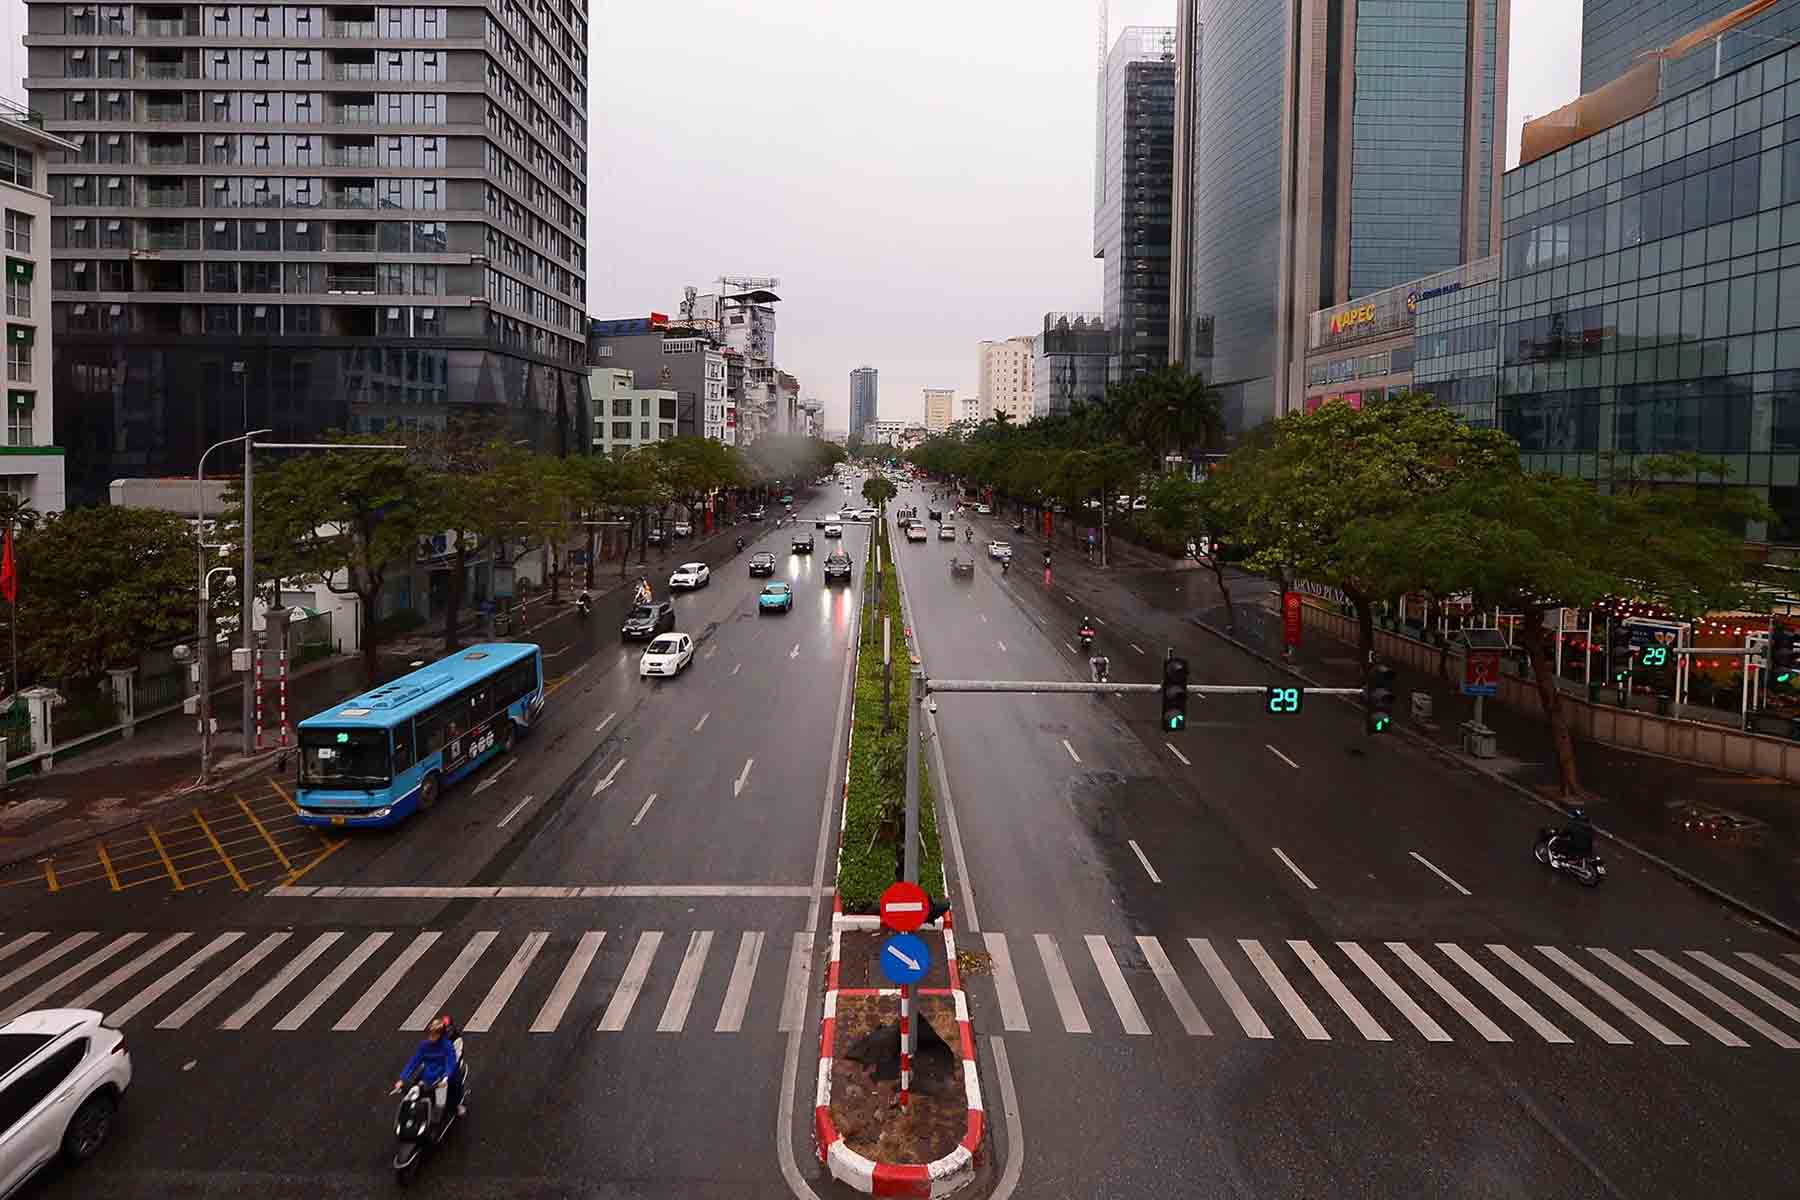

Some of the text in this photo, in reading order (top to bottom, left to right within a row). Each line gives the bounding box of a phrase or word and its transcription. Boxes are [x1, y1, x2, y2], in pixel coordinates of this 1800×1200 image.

[1343, 304, 1376, 322] APEC
[1643, 647, 1666, 665] 29
[1270, 688, 1298, 711] 29
